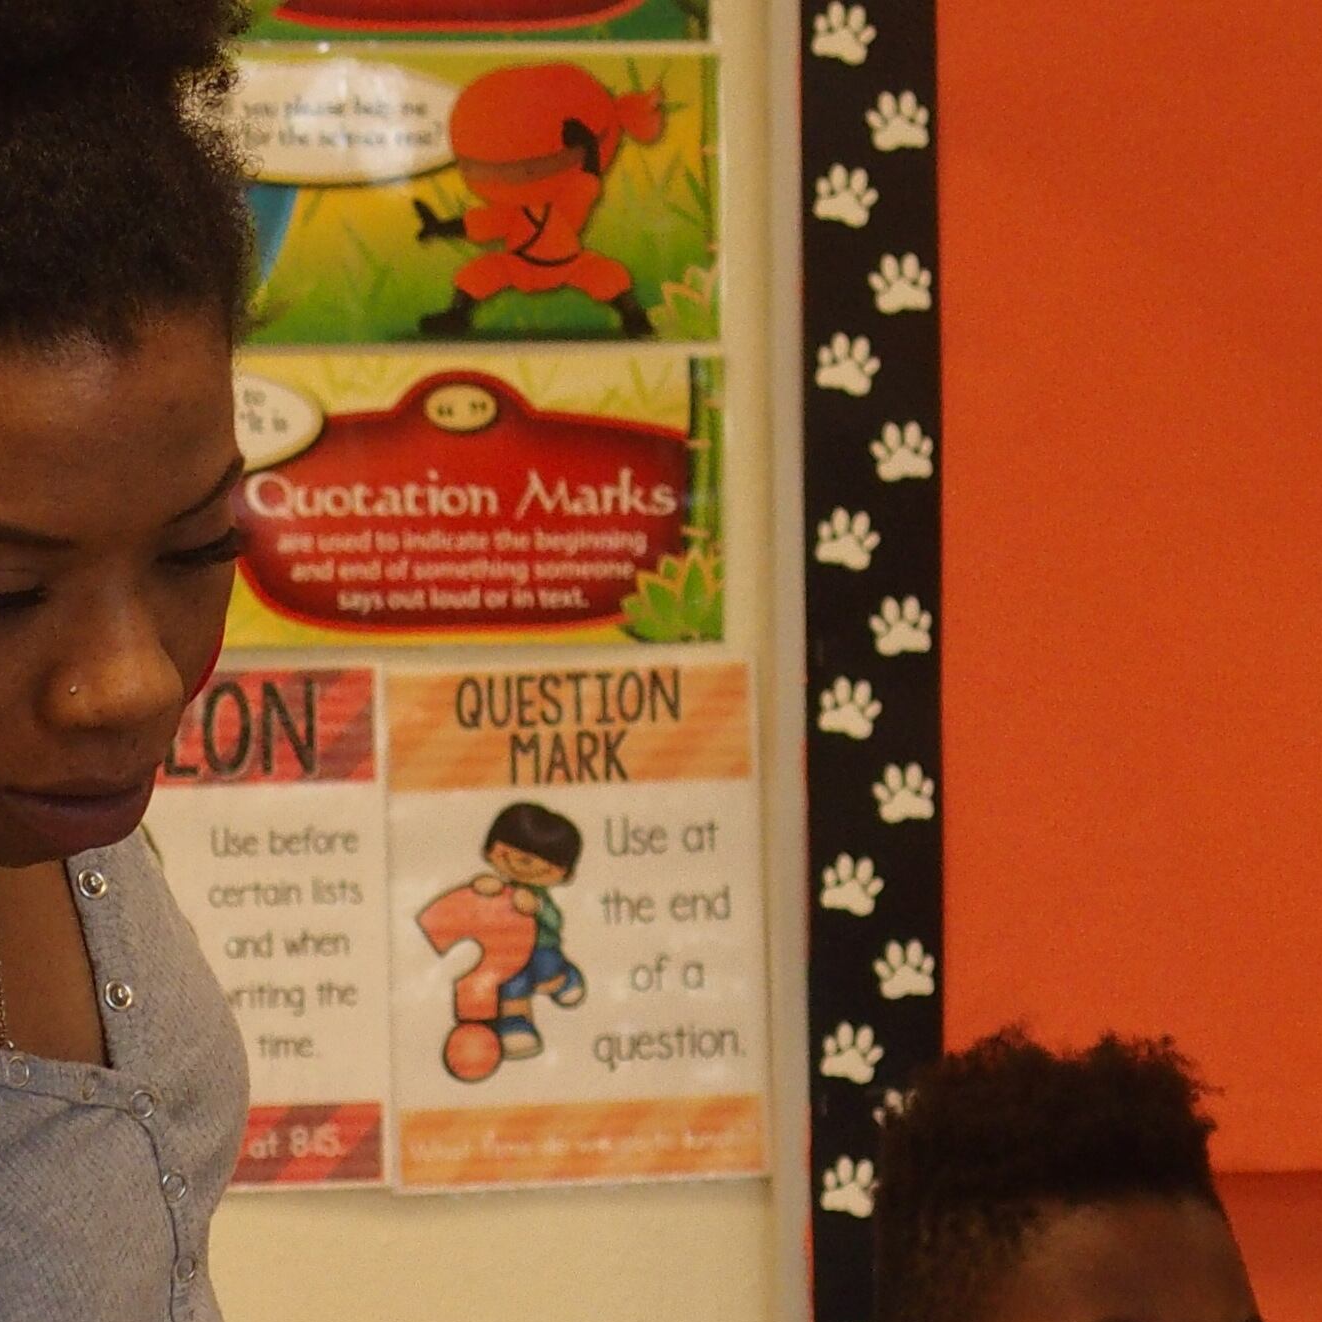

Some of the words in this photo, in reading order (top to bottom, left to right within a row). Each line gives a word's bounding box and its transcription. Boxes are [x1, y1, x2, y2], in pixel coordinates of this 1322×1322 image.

[244, 470, 499, 520] Quotation
[516, 467, 678, 519] Marks
[278, 533, 313, 553] are
[319, 529, 371, 554] used
[375, 530, 399, 553] to
[402, 527, 488, 552] indicate
[494, 527, 531, 552] the
[534, 528, 648, 558] beginning
[290, 558, 334, 581] and
[339, 557, 381, 581] end
[385, 557, 410, 580] of
[413, 557, 529, 587] something
[534, 560, 636, 580] someone
[337, 589, 382, 614] says
[387, 588, 425, 609] out
[429, 585, 481, 609] loud
[485, 589, 510, 609] or
[513, 585, 535, 609] in
[538, 588, 588, 609] text.
[455, 668, 682, 730] QUESTION
[509, 730, 631, 785] MARK
[209, 826, 258, 858] Use
[269, 824, 359, 857] before
[604, 815, 668, 857] Use
[681, 815, 719, 853] at
[207, 880, 301, 908] certain
[310, 878, 364, 906] lists
[600, 889, 655, 926] the
[669, 886, 731, 922] end
[224, 930, 272, 959] and
[283, 928, 351, 957] when
[629, 956, 671, 993] of
[682, 961, 705, 989] a
[317, 978, 358, 1007] the
[591, 1022, 747, 1070] question.
[247, 1127, 279, 1159] at
